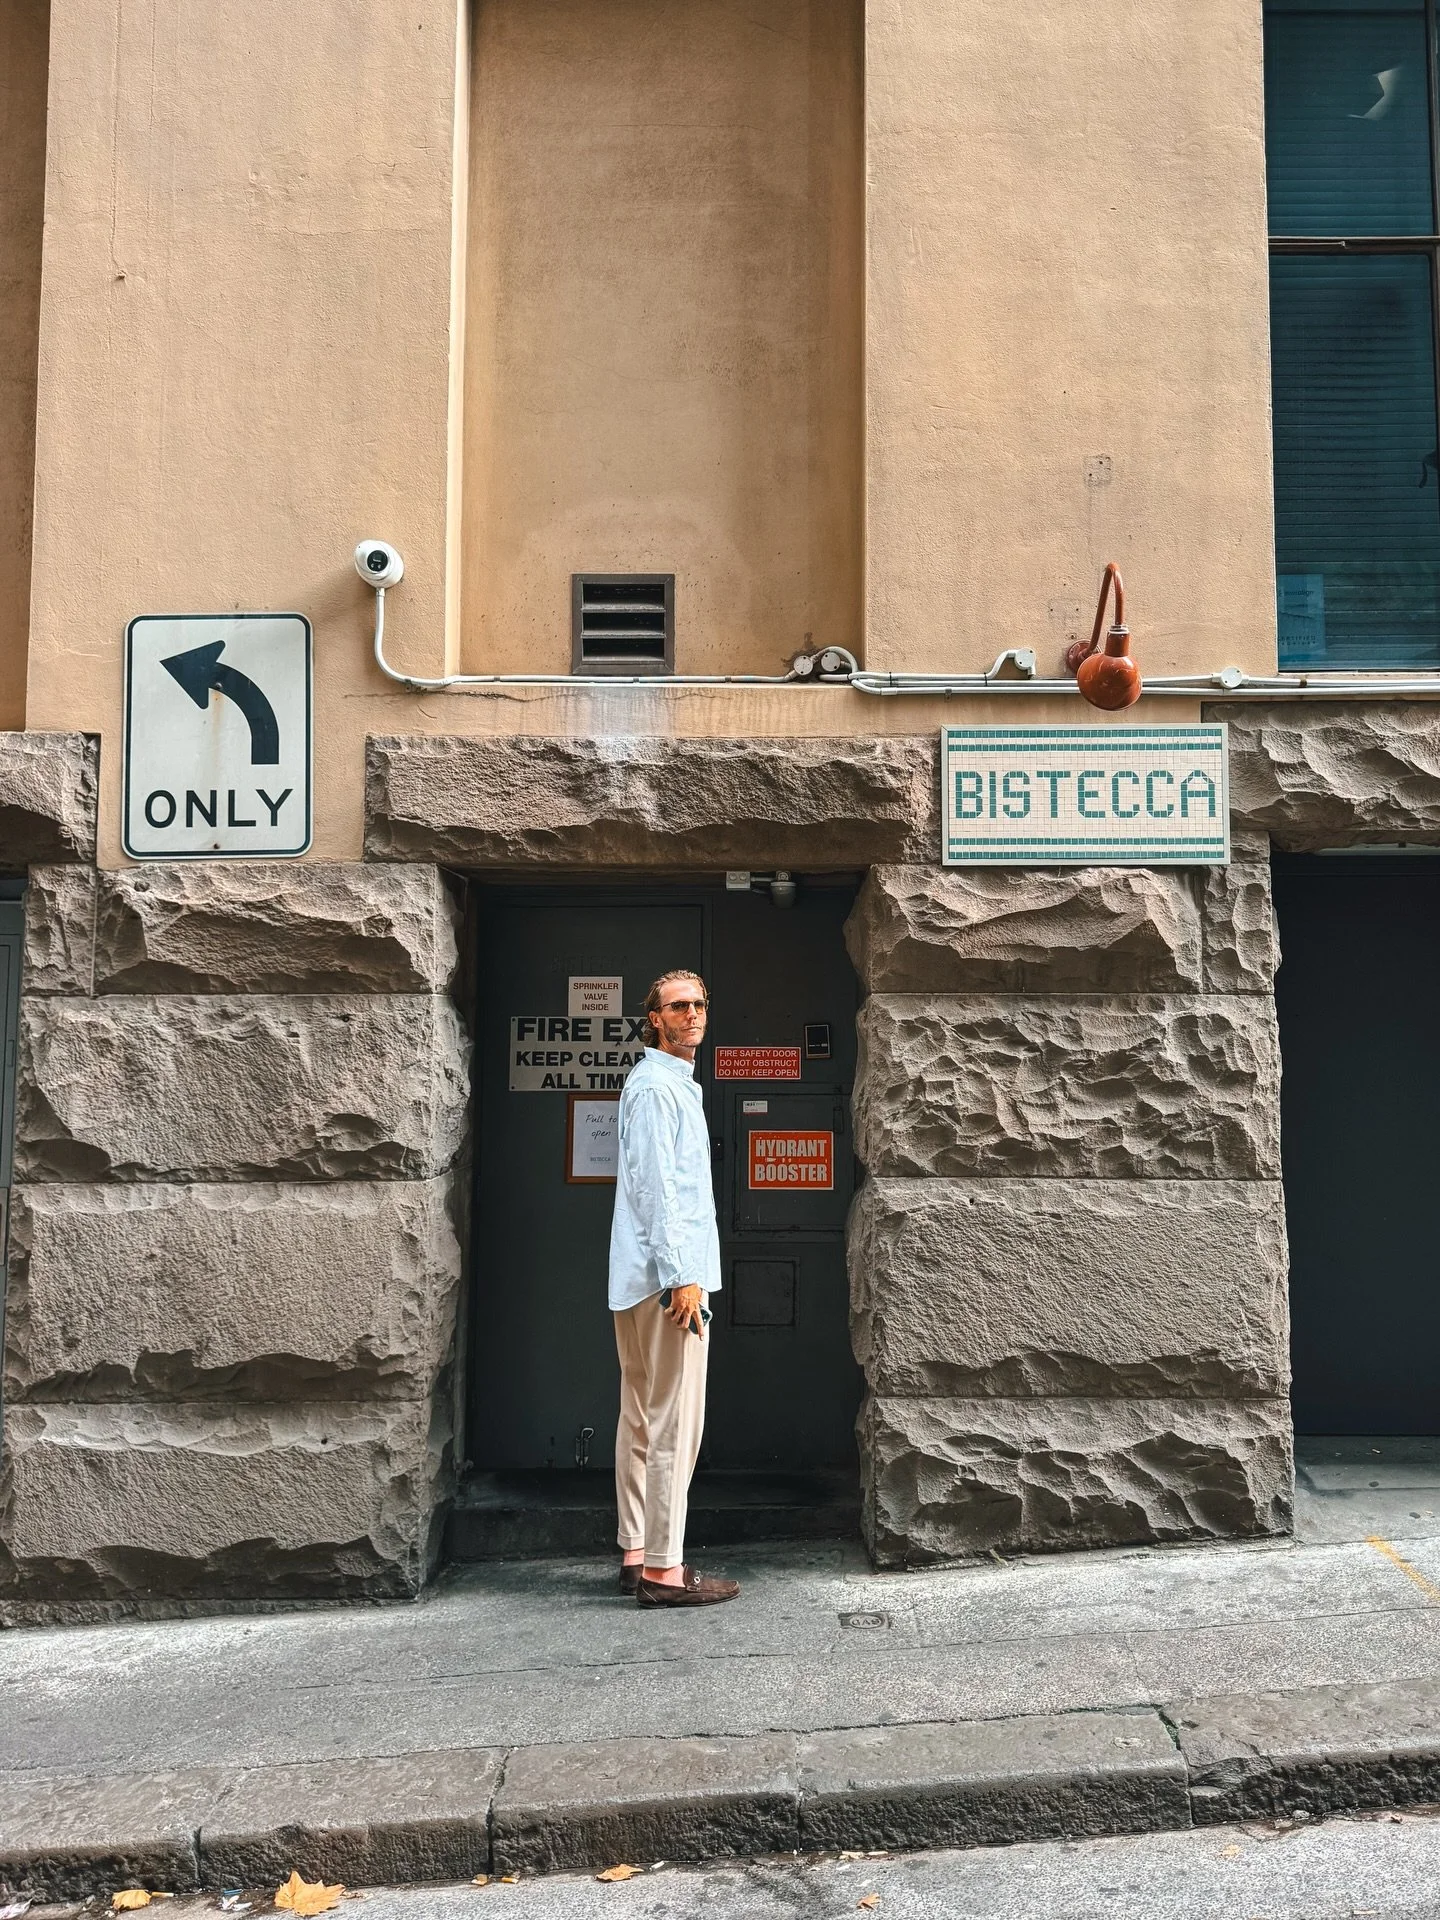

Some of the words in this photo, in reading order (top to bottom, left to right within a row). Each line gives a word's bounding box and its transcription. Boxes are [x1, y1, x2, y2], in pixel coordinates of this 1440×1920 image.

[955, 770, 1216, 818] BISTECCA
[145, 789, 293, 828] ONLY
[573, 982, 619, 990] SPRINKLER
[517, 1018, 592, 1042] FIRE
[602, 1018, 645, 1042] EX
[516, 1051, 573, 1066] KEEP
[541, 1073, 581, 1089] ALL
[586, 1073, 629, 1089] TIM
[586, 1114, 604, 1123] Pull
[609, 1115, 617, 1123] to
[591, 1130, 611, 1140] open
[755, 1139, 827, 1157] HYDRANT
[754, 1163, 828, 1182] BOOSTER
[851, 1618, 880, 1626] GAS
